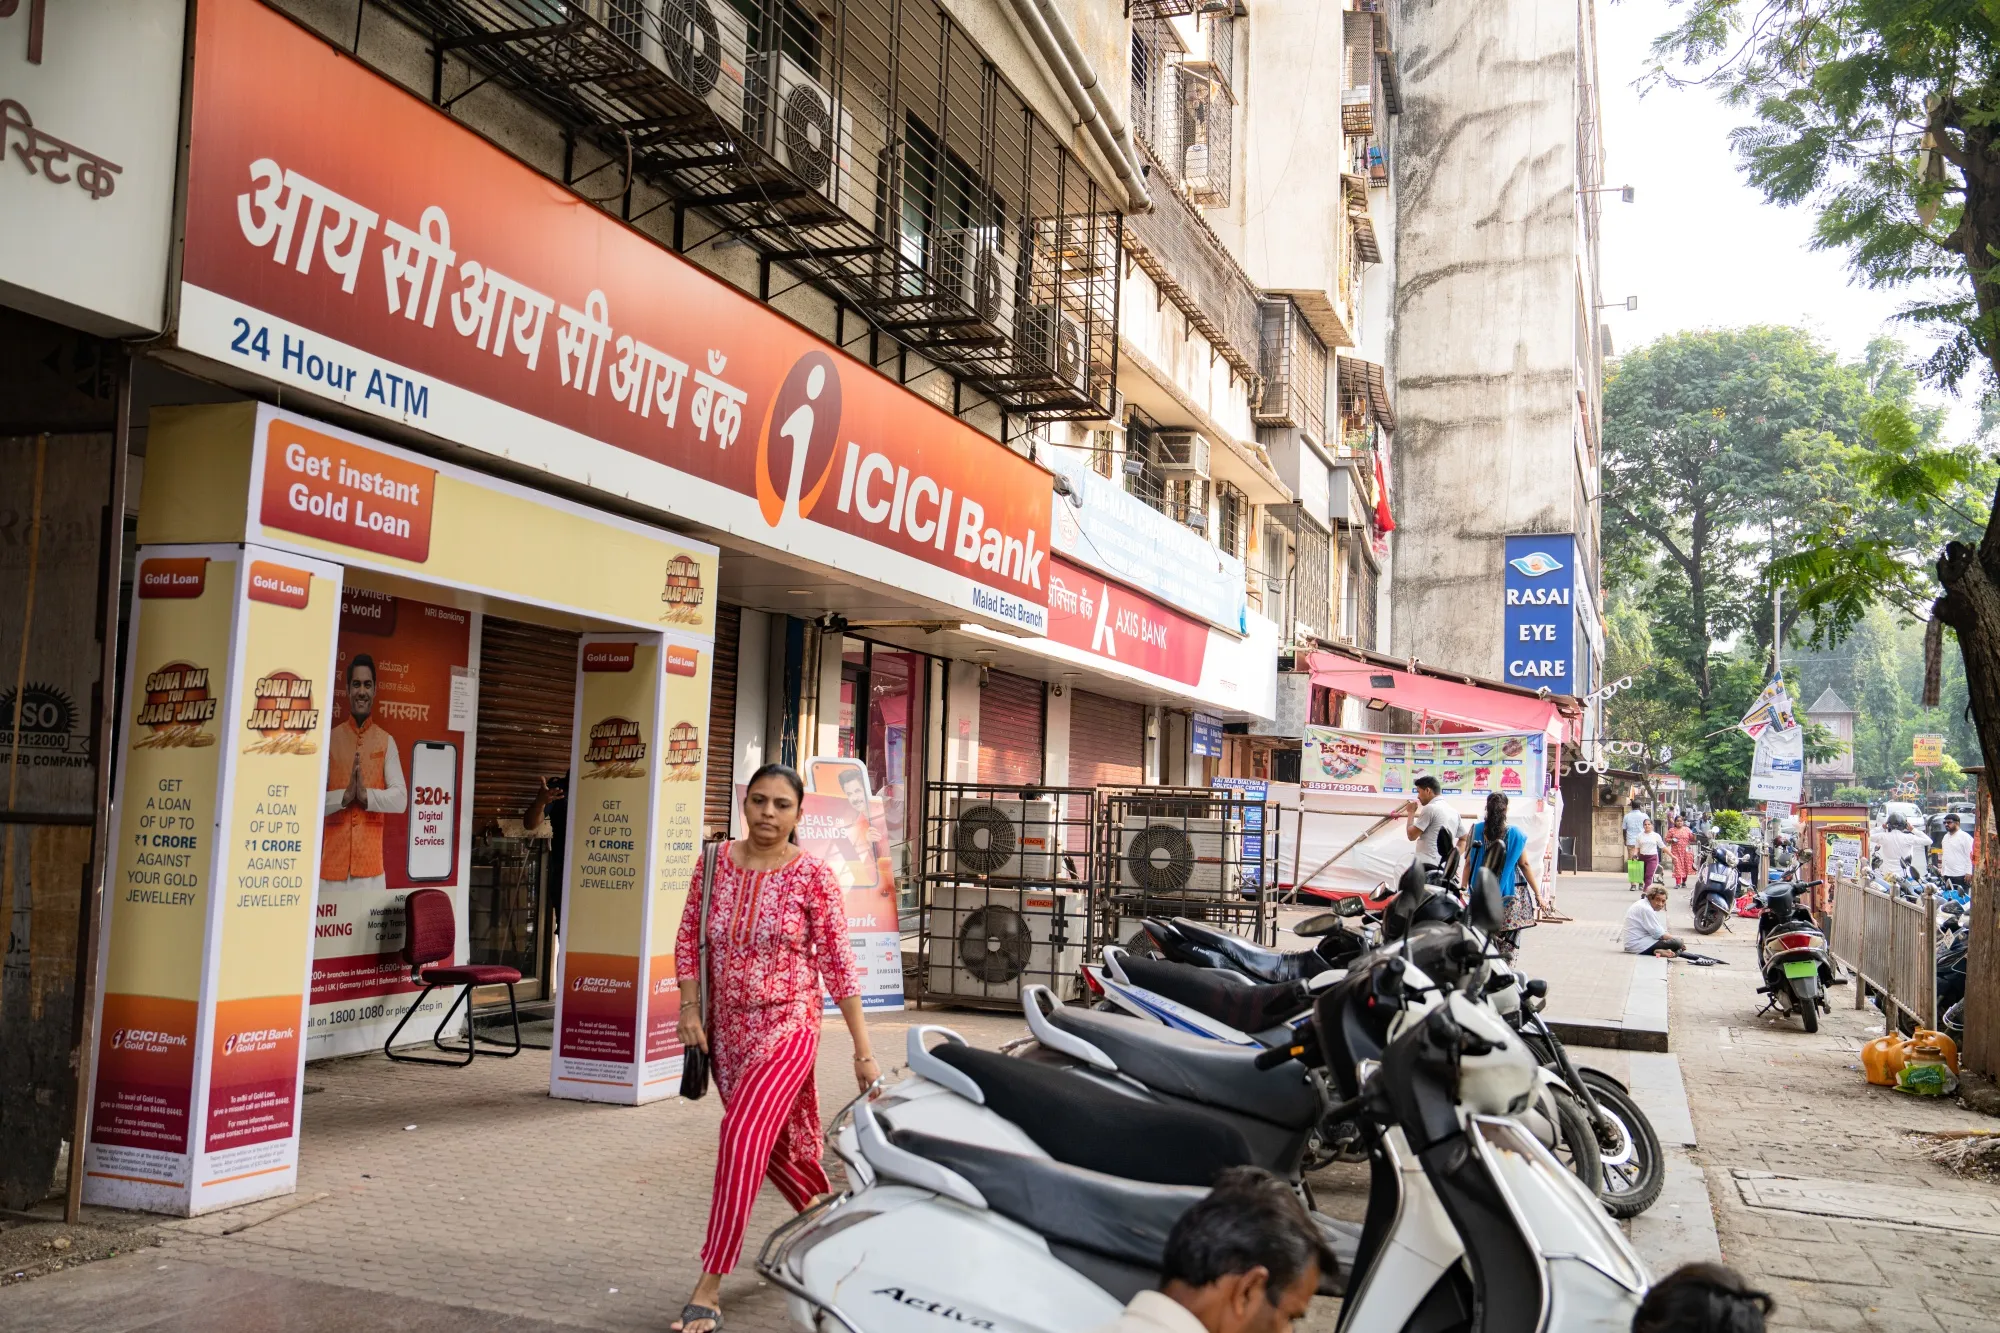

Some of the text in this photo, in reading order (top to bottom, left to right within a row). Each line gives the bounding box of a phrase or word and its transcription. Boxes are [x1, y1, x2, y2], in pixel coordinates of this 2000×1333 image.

[237, 158, 379, 294] आय
[382, 205, 456, 328] सी
[451, 260, 555, 371] आय
[557, 289, 613, 396] सी
[609, 335, 689, 429] आय
[230, 316, 430, 419] 24 Hour ATM
[285, 443, 420, 506] Get instant
[288, 483, 410, 539] Gold Loan
[837, 441, 953, 551] ICICI
[954, 496, 1045, 591] Bank
[666, 559, 700, 579] SONA HAI
[144, 573, 199, 585] Gold Loan
[253, 575, 304, 596] Gold Loan
[661, 586, 704, 604] JAAG JAIYE
[1506, 587, 1570, 606] RASAI
[351, 604, 382, 619] world
[425, 607, 465, 624] NRI Banking
[972, 587, 1043, 629] Malad East Branch
[1115, 607, 1168, 650] AXIS BANK
[1519, 624, 1557, 641] EYE
[1509, 659, 1566, 677] CARE
[146, 668, 209, 692] SONA HAI
[255, 678, 286, 697] SONA
[290, 680, 312, 698] HAI
[137, 698, 217, 726] JAAG JAIYE
[379, 700, 430, 722] नमस्कार
[247, 709, 282, 730] JAAG
[283, 709, 319, 730] JAIYE
[33, 755, 90, 768] COMPANY
[159, 779, 183, 792] GET
[267, 784, 289, 797] GET
[1308, 782, 1370, 793] 8591799904
[414, 786, 451, 806] 320+
[146, 797, 192, 811] A LOAN
[255, 802, 297, 816] A LOAN
[602, 800, 622, 810] GET
[140, 815, 195, 830] OF UP TO
[418, 811, 443, 822] Digital
[593, 813, 629, 823] A LOAN
[250, 820, 300, 834] OF UP TO
[423, 825, 437, 834] NRI
[589, 826, 632, 837] OF UP TO
[798, 827, 848, 839] BRANDS
[152, 834, 197, 849] CRORE
[261, 839, 302, 852] CRORE
[414, 836, 445, 846] Services
[599, 840, 634, 850] CRORE
[1019, 838, 1045, 846] ITACHI
[136, 853, 191, 868] AGAINST
[247, 858, 297, 871] AGAINST
[588, 853, 630, 863] AGAINST
[580, 865, 635, 877] YOUR GOLD
[127, 871, 198, 887] YOUR GOLD
[238, 876, 302, 889] YOUR GOLD
[580, 879, 634, 890] JEWELLERY
[126, 890, 196, 906] JEWELLERY
[237, 894, 300, 908] JEWELLERY
[316, 904, 337, 918] NRI
[370, 907, 392, 916] Wealth
[368, 920, 388, 929] Money
[847, 914, 877, 927] ank
[315, 923, 352, 938] NKING
[375, 932, 385, 941] Car
[327, 970, 349, 979] branches
[379, 963, 400, 973] 5,600+
[310, 984, 325, 993] nada
[328, 983, 336, 991] UK
[340, 980, 361, 990] Germany
[379, 976, 398, 985] Bahrain
[317, 1017, 327, 1026] on
[330, 1009, 355, 1025] 1800
[359, 1005, 384, 1021] 1080
[386, 1008, 393, 1016] or
[419, 1002, 433, 1014] step
[435, 1002, 443, 1010] in
[126, 1029, 188, 1046] ICICI Bank
[238, 1030, 267, 1043] ICICI
[268, 1027, 293, 1040] Bank
[124, 1041, 168, 1053] Gold Loan
[236, 1041, 277, 1053] Gold Loan
[871, 1286, 996, 1331] Activa
